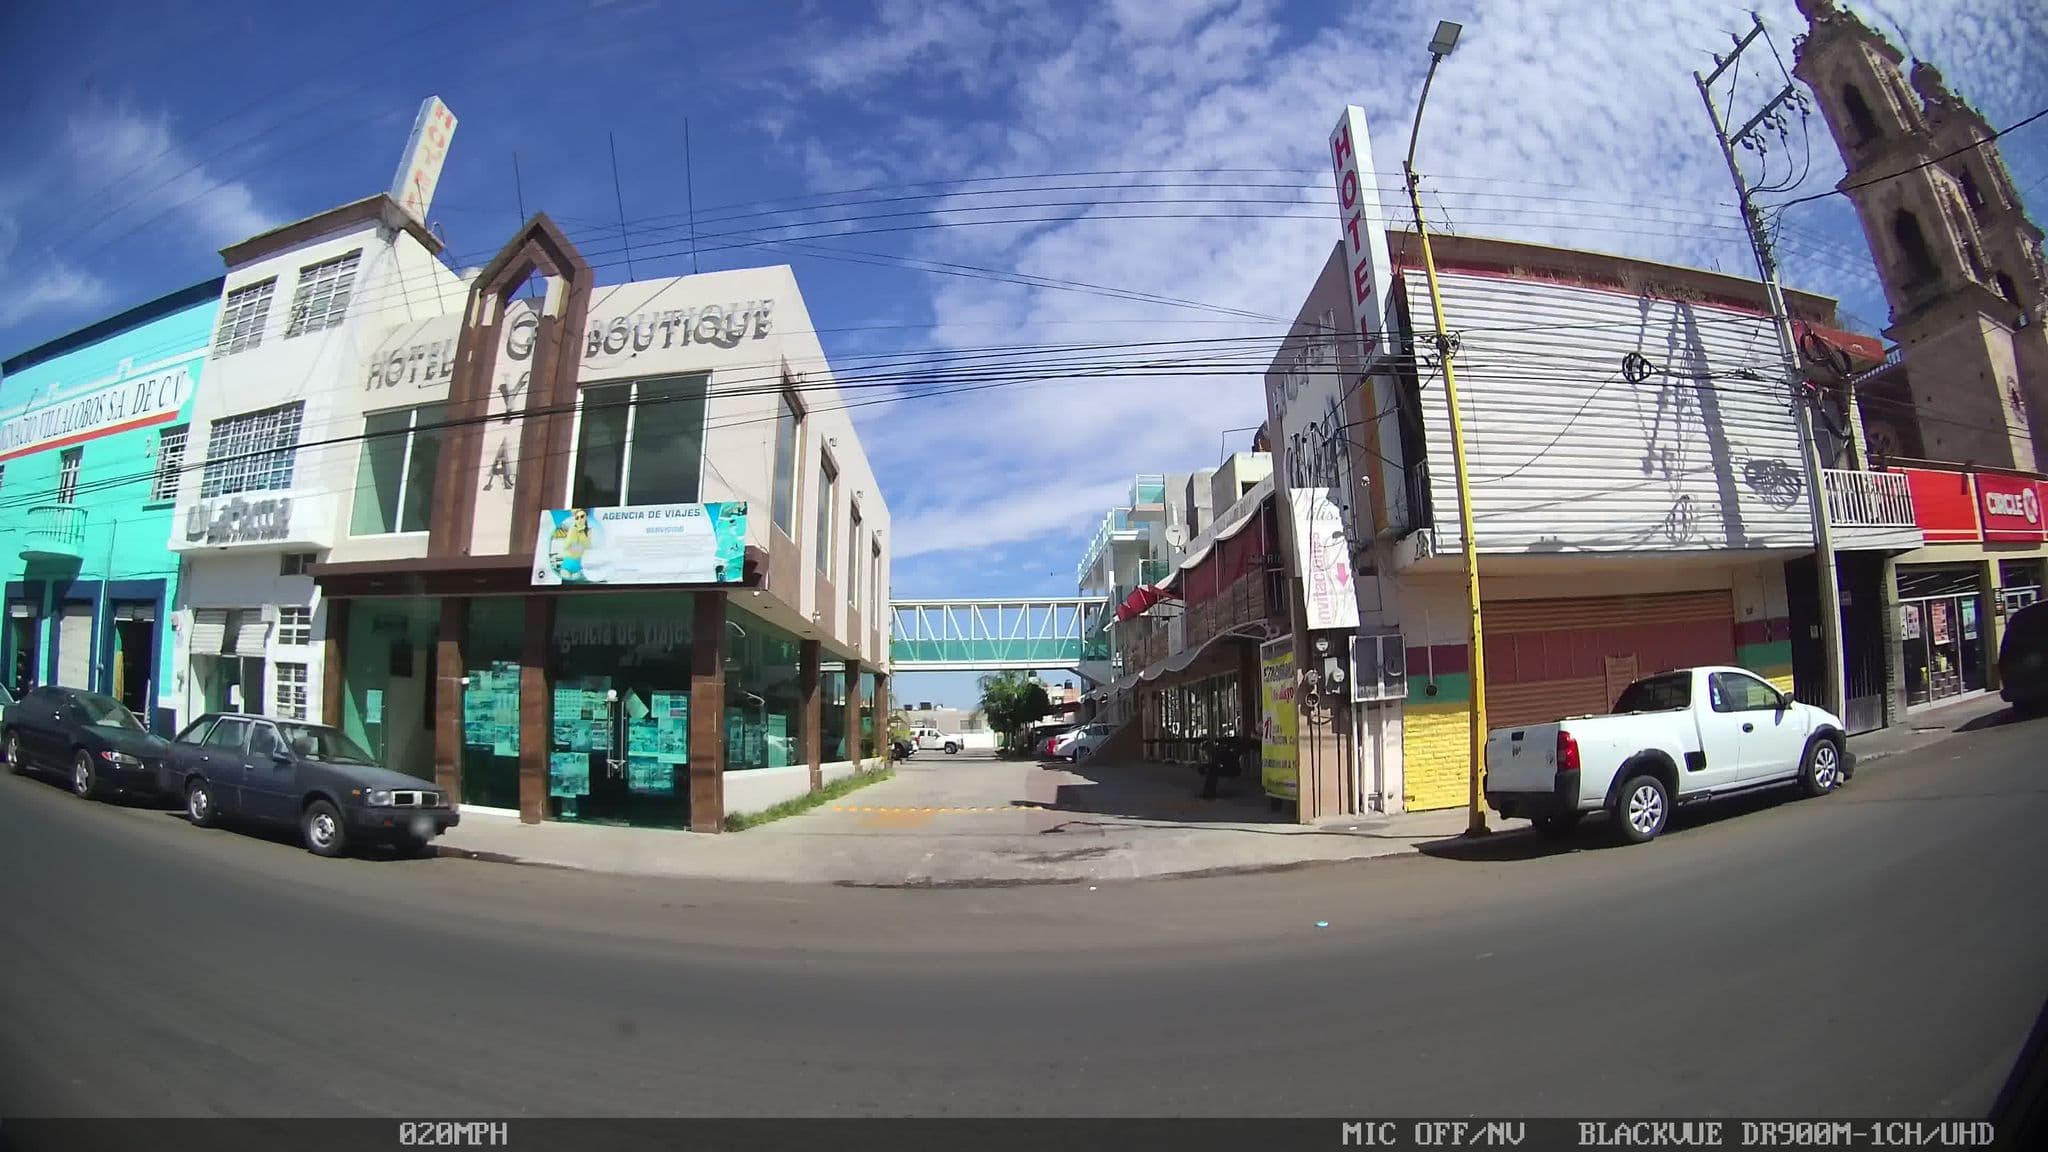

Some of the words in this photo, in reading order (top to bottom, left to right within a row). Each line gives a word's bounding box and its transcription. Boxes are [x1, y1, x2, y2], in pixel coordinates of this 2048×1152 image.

[1334, 125, 1376, 355] HOTEL
[585, 299, 774, 358] BOUTIQUE
[364, 339, 455, 391] HOTEL
[132, 379, 156, 415] DE
[602, 510, 644, 521] AGENCIA
[648, 509, 661, 519] DE
[665, 507, 701, 518] VIAJES
[1986, 492, 2025, 515] CIRCLE
